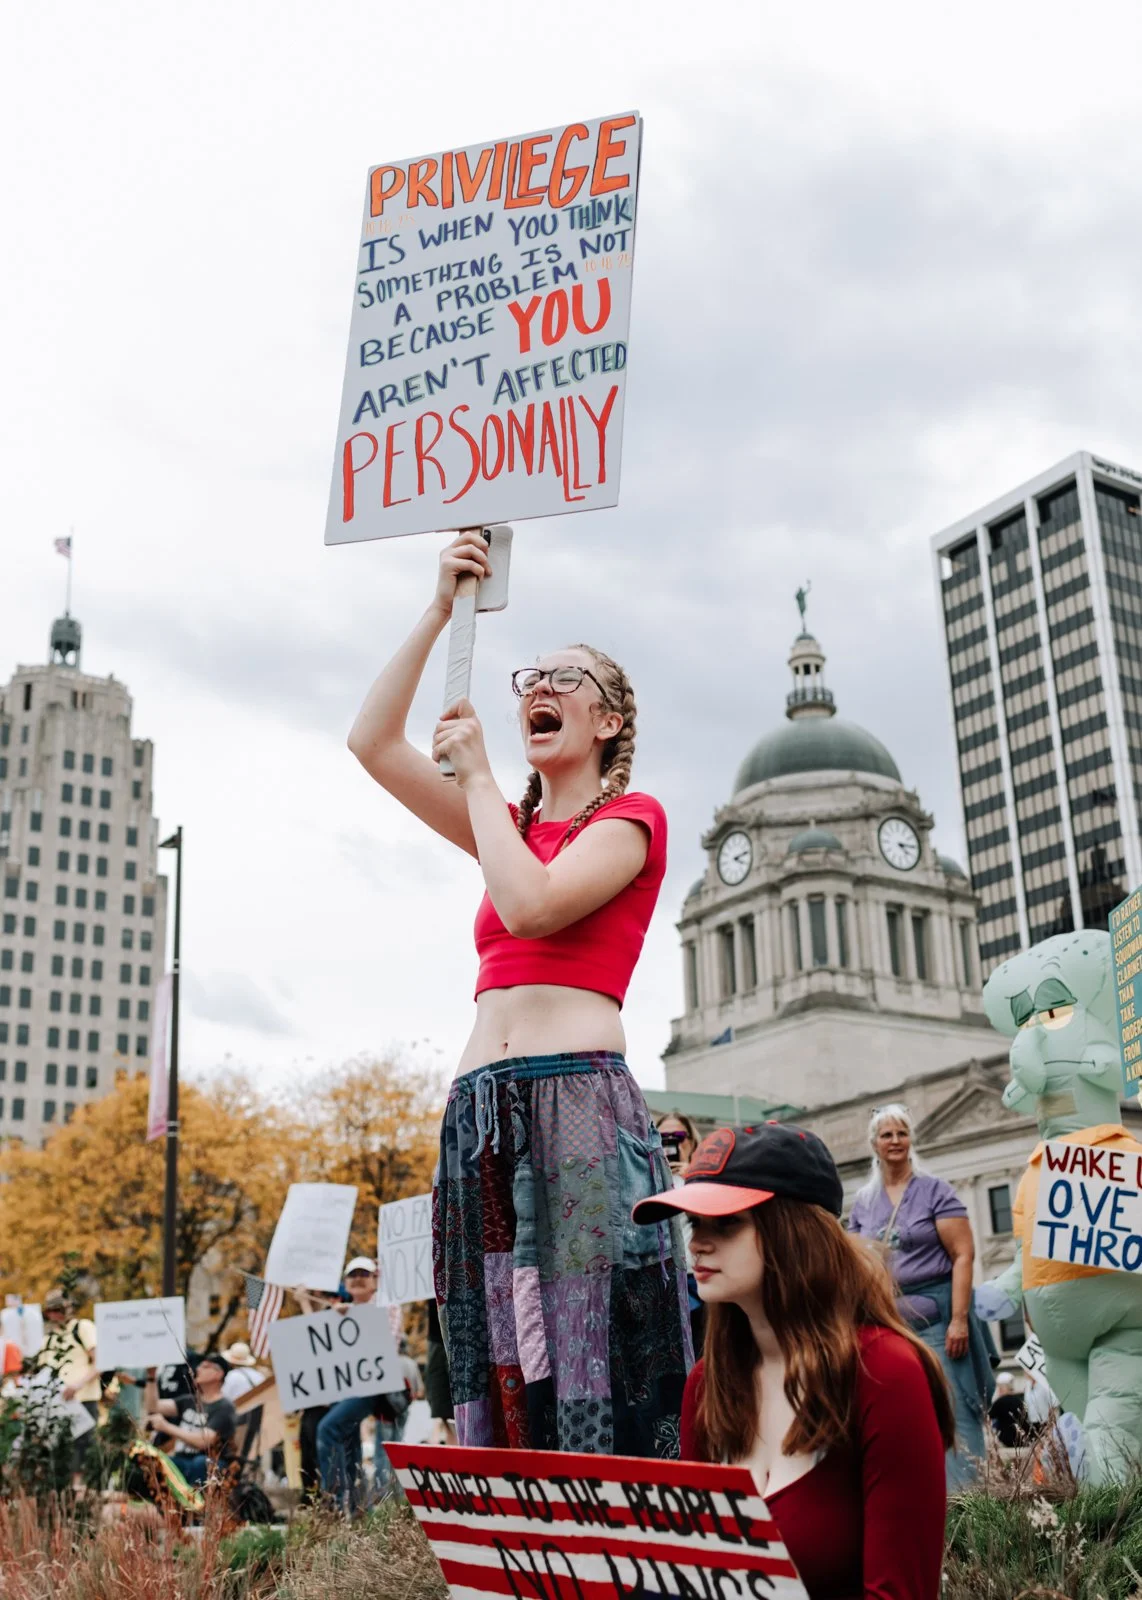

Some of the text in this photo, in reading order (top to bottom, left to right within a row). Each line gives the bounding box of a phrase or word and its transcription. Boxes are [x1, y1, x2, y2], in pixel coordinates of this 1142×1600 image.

[370, 115, 636, 218] PRIVILEGE
[358, 193, 635, 275] IS WHEN YOU THINK
[357, 228, 632, 309] SOMETHING IS NOT
[393, 262, 578, 327] A PROBLEM
[359, 277, 612, 368] BECAUSE YOU
[352, 341, 628, 426] AREN'T AFFECTED
[342, 385, 619, 523] PERSONALLY
[1113, 914, 1140, 949] LISTEN TO
[1120, 891, 1142, 923] RATHER
[1118, 982, 1135, 1006] THAN
[1120, 1002, 1135, 1025] TAKE
[1123, 1039, 1141, 1063] FROM
[1045, 1144, 1126, 1183] WAKE
[381, 1205, 406, 1242] NO
[411, 1199, 432, 1234] FA
[1048, 1179, 1138, 1233] OVE
[1037, 1220, 1142, 1272] THRO
[307, 1316, 360, 1355] NO
[289, 1355, 385, 1398] KINGS
[406, 1461, 771, 1550] POWER TO THE PEOPLE
